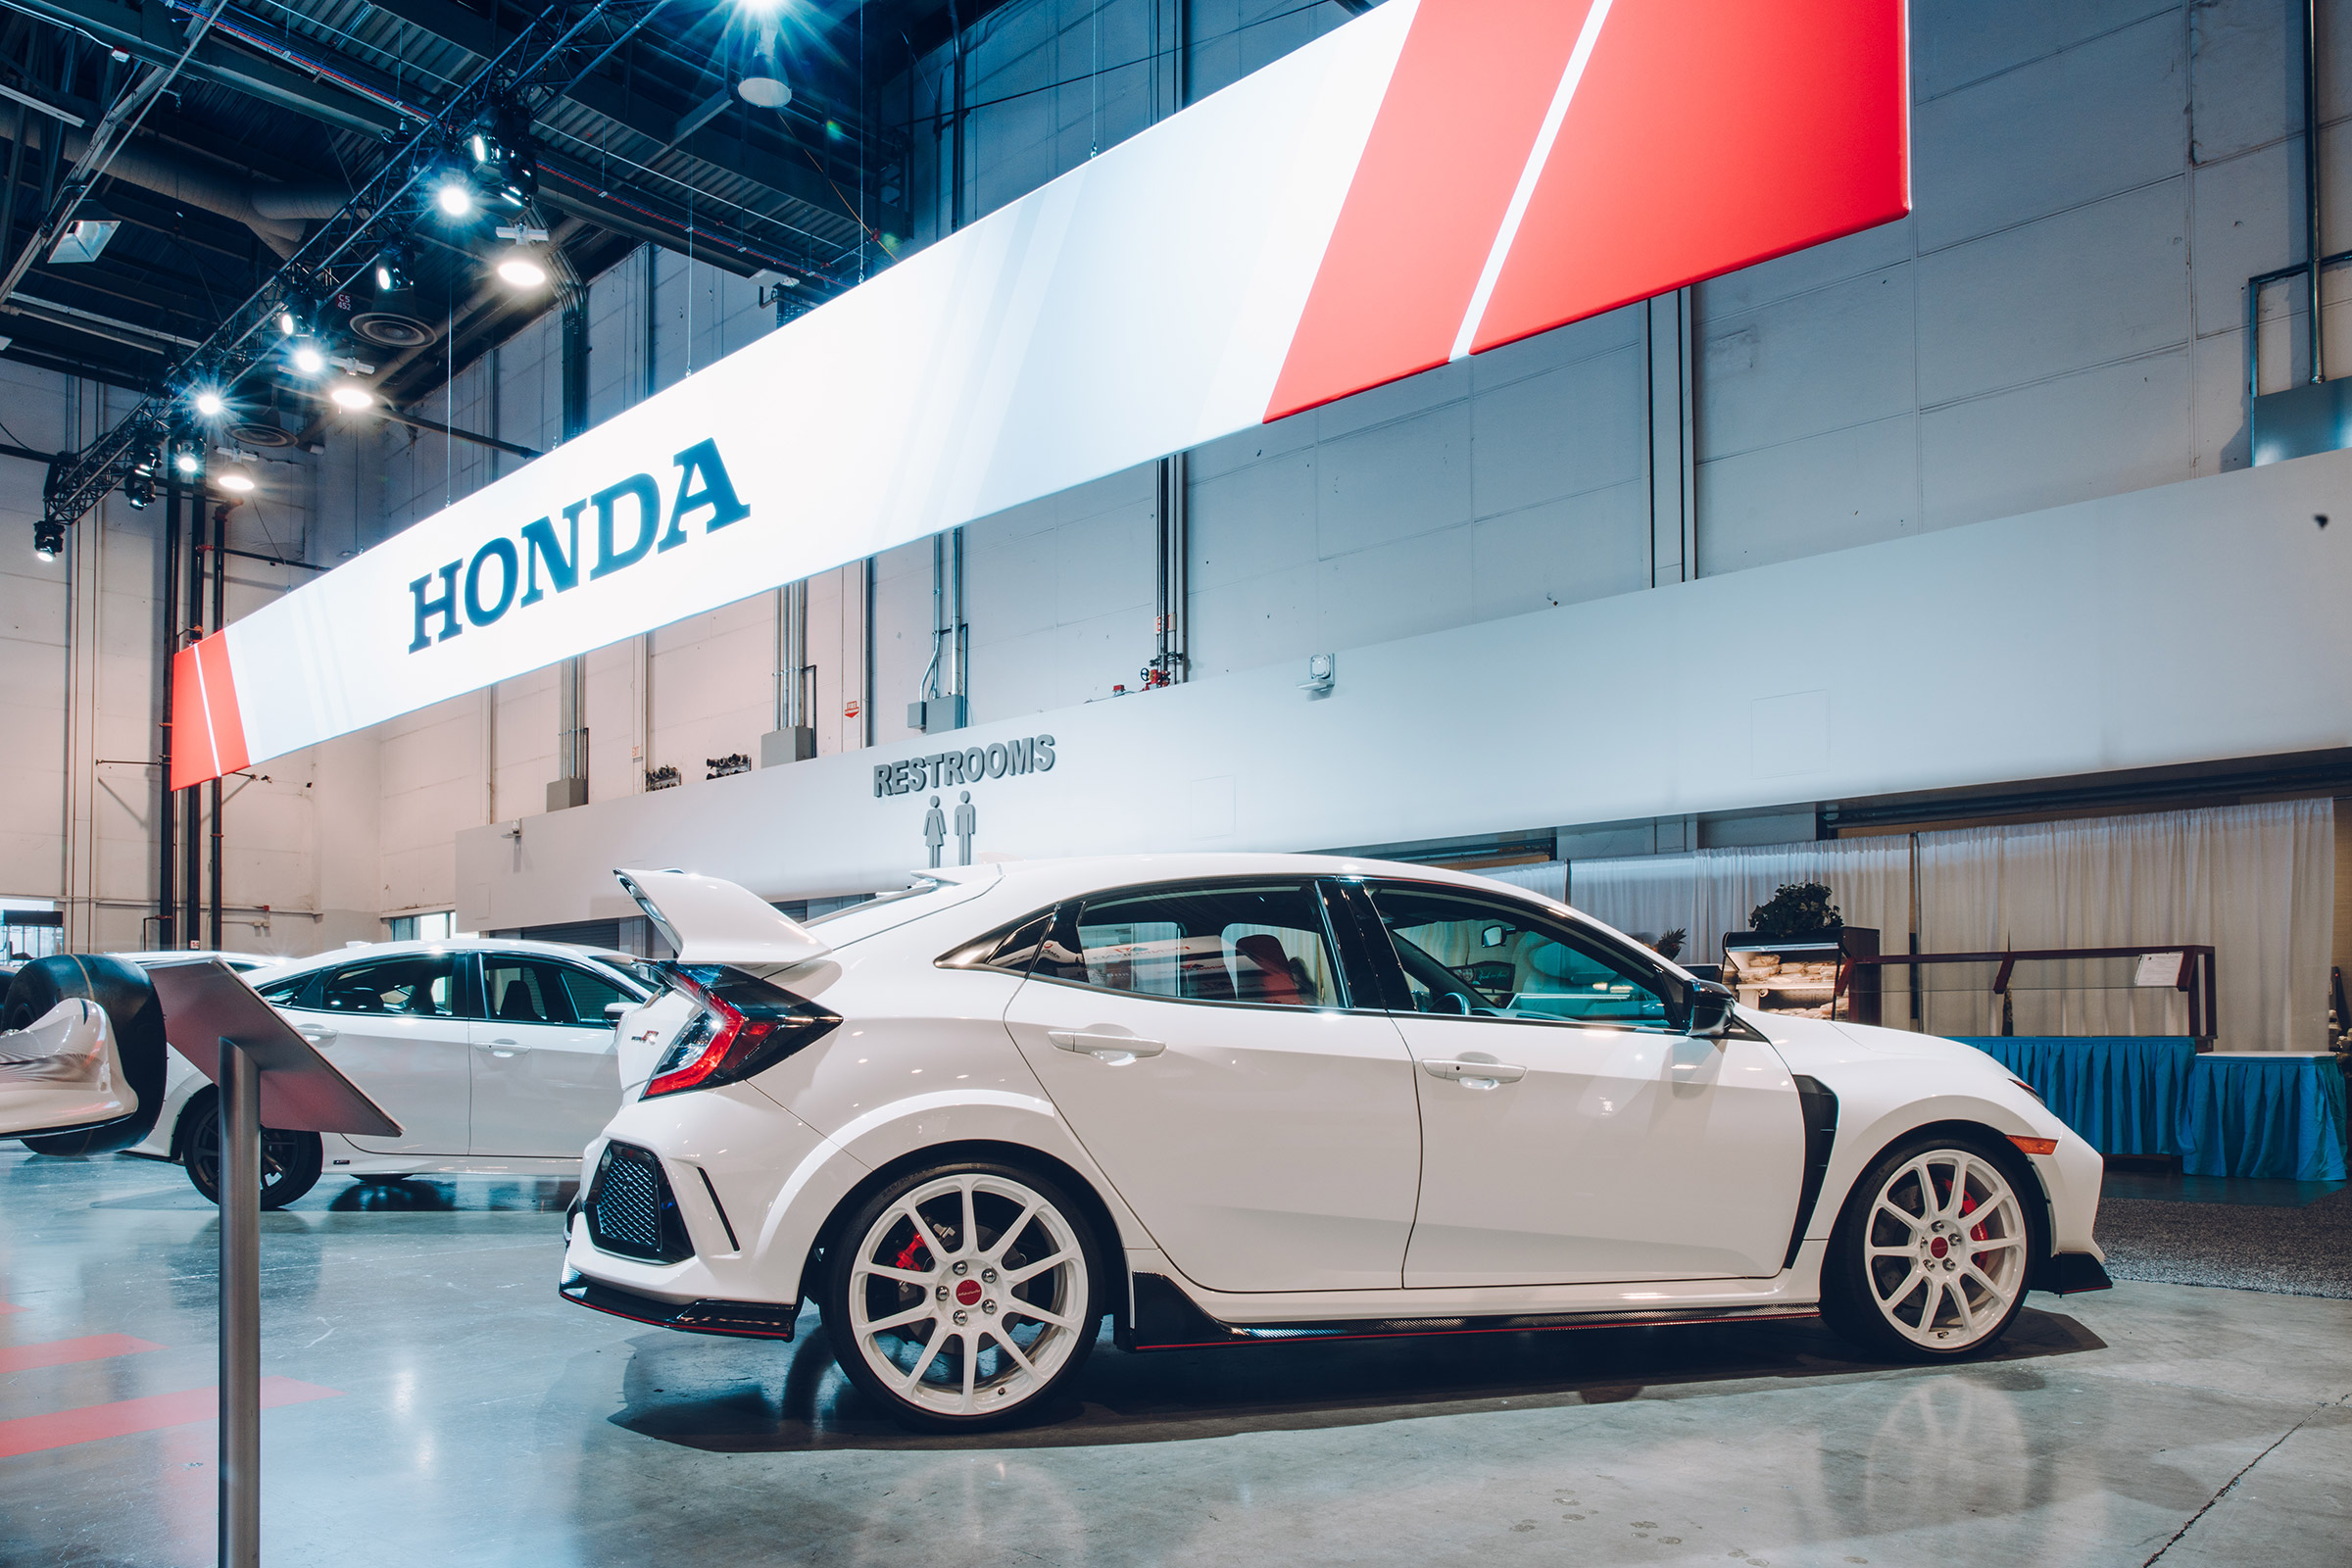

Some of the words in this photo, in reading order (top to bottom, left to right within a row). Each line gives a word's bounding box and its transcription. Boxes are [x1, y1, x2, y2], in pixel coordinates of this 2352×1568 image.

[337, 302, 352, 311] 452
[408, 436, 752, 656] HONDA
[873, 734, 1056, 799] RESTROOMS
